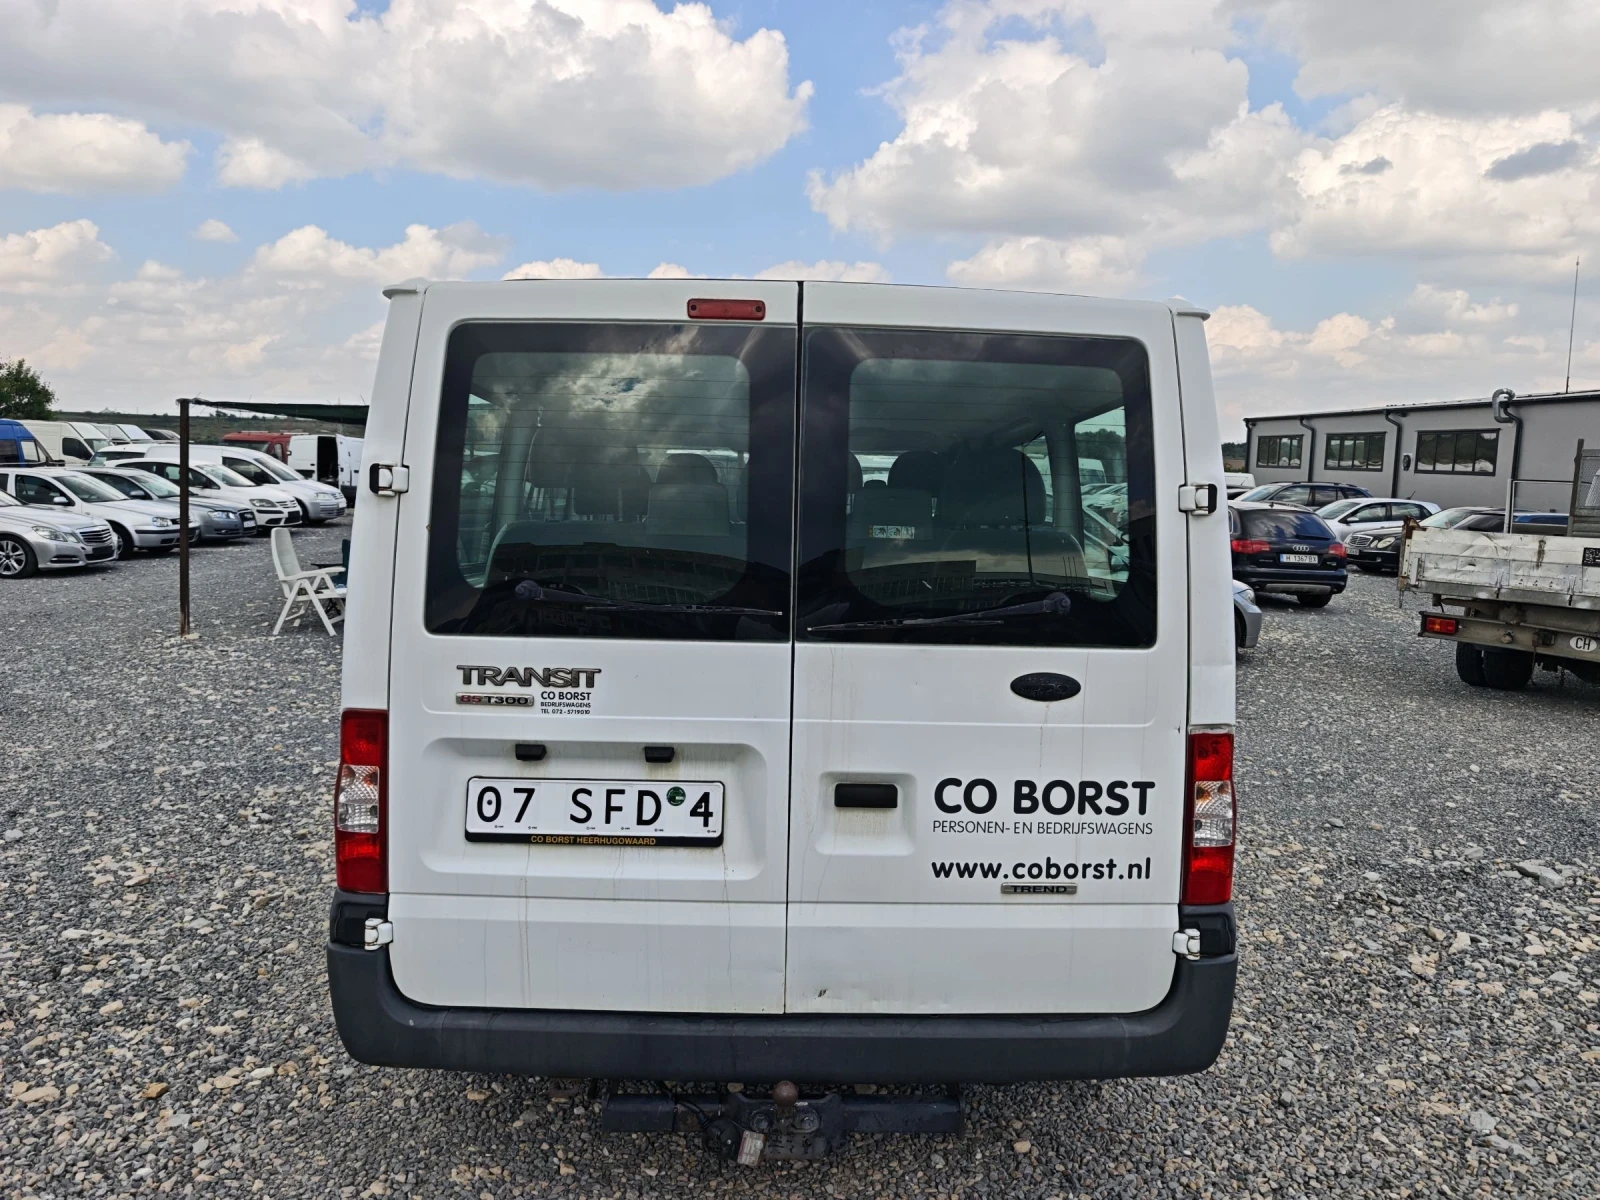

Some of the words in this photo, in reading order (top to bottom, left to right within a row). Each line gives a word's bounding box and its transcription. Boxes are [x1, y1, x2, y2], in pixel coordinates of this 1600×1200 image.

[1576, 637, 1591, 650] CH
[456, 664, 602, 688] TRANSIT
[540, 691, 556, 701] CO
[558, 691, 592, 701] BORST
[934, 777, 998, 814] CO
[1013, 779, 1156, 816] BORST
[476, 785, 536, 823] 07
[569, 787, 662, 826] SFD
[689, 791, 714, 828] 4
[932, 820, 1010, 834] PERSONEN-
[1013, 821, 1033, 834] EN
[1037, 821, 1153, 835] BEDRIJFSWAGENS
[530, 835, 545, 844] CO
[545, 835, 575, 844] BORST
[576, 836, 657, 846] HEERHUGOWAARD
[931, 856, 1152, 880] www.coborst.nl
[1010, 885, 1068, 893] TREND
